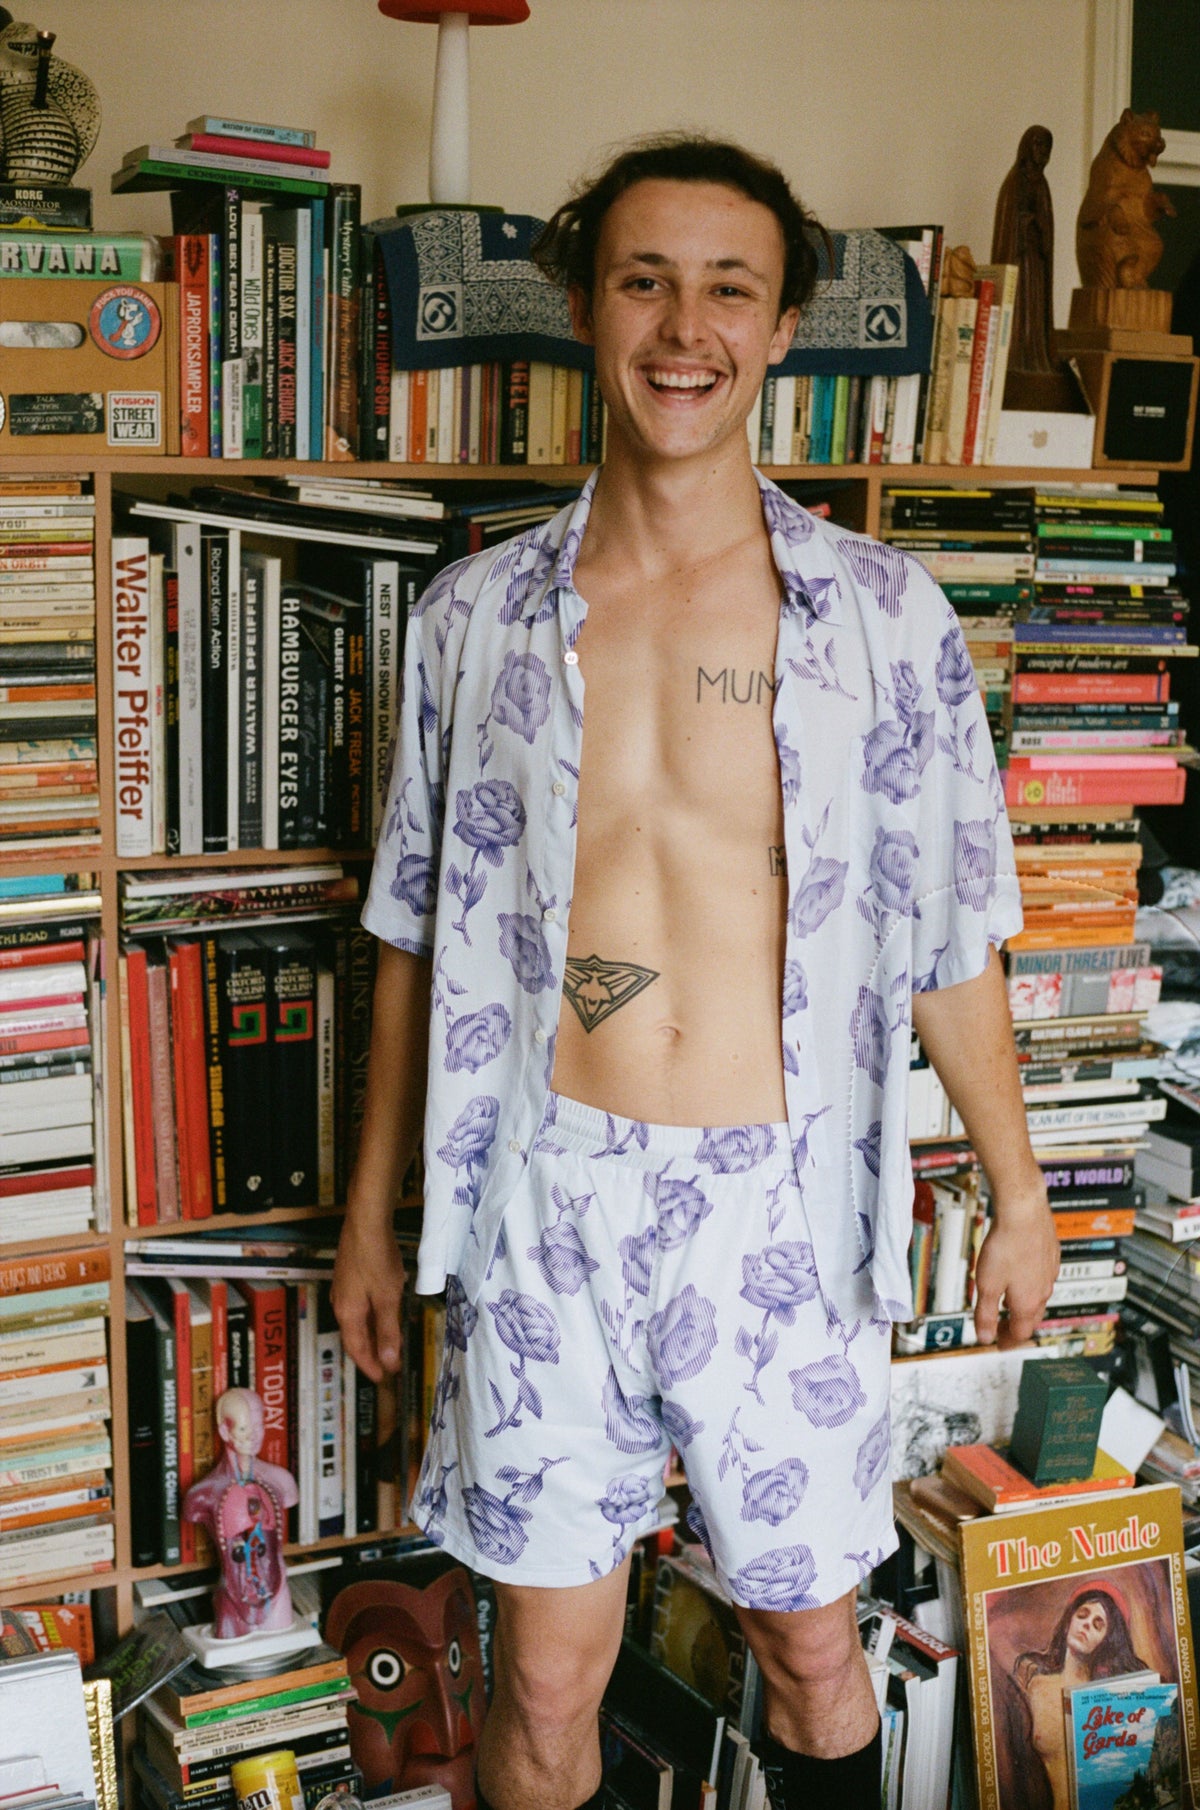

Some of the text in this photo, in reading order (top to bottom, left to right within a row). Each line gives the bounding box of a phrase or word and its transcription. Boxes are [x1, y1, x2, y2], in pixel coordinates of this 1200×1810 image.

[15, 189, 43, 200] KORG
[339, 221, 354, 263] Mystery
[117, 287, 134, 298] YOU
[229, 206, 238, 354] LOVE SEX FEAR DEATH
[341, 268, 353, 297] Cults
[243, 309, 262, 341] Ones
[278, 246, 296, 425] DOCTOR SAX JACK KEROUAC
[186, 292, 203, 413] JAPROCKSAMPLER
[374, 332, 391, 415] THOMPSON
[113, 397, 156, 406] VISION
[113, 408, 155, 421] STREET
[116, 423, 153, 439] WEAR
[210, 547, 222, 669] Richard Kern Action
[245, 578, 257, 671] PFEIFFER
[378, 583, 391, 743] NEST DASH SNOW DAN
[116, 554, 149, 820] Walter Pfeiffer
[281, 598, 300, 809] HAMBURGER EYES
[333, 627, 344, 748] GILBERT & GEORGE
[245, 676, 257, 755] WALTER
[349, 688, 363, 724] JACK
[349, 731, 363, 777] FREAK
[19, 930, 48, 943] ROAD
[274, 973, 313, 984] OXFORD
[1016, 947, 1149, 975] MINOR THREAT LIVE
[226, 975, 266, 988] OXFORD
[226, 984, 266, 997] ENGLISH
[274, 982, 313, 994] ENGLISH
[323, 1018, 331, 1043] THE
[323, 1047, 331, 1089] EARLY
[1074, 1166, 1124, 1186] WORLD
[262, 1309, 285, 1431] USA TODAY
[164, 1379, 177, 1424] MISERY
[164, 1430, 177, 1467] LOVES
[21, 1462, 69, 1482] TRUST ME
[987, 1515, 1161, 1578] The Nude
[1172, 1551, 1188, 1626] MICHELANGELO
[1180, 1636, 1193, 1685] CRANACH
[973, 1592, 995, 1788] RENOIR MANET BOUCHER DELACROIX
[1082, 1705, 1147, 1732] Lake of
[1083, 1730, 1138, 1761] Garda
